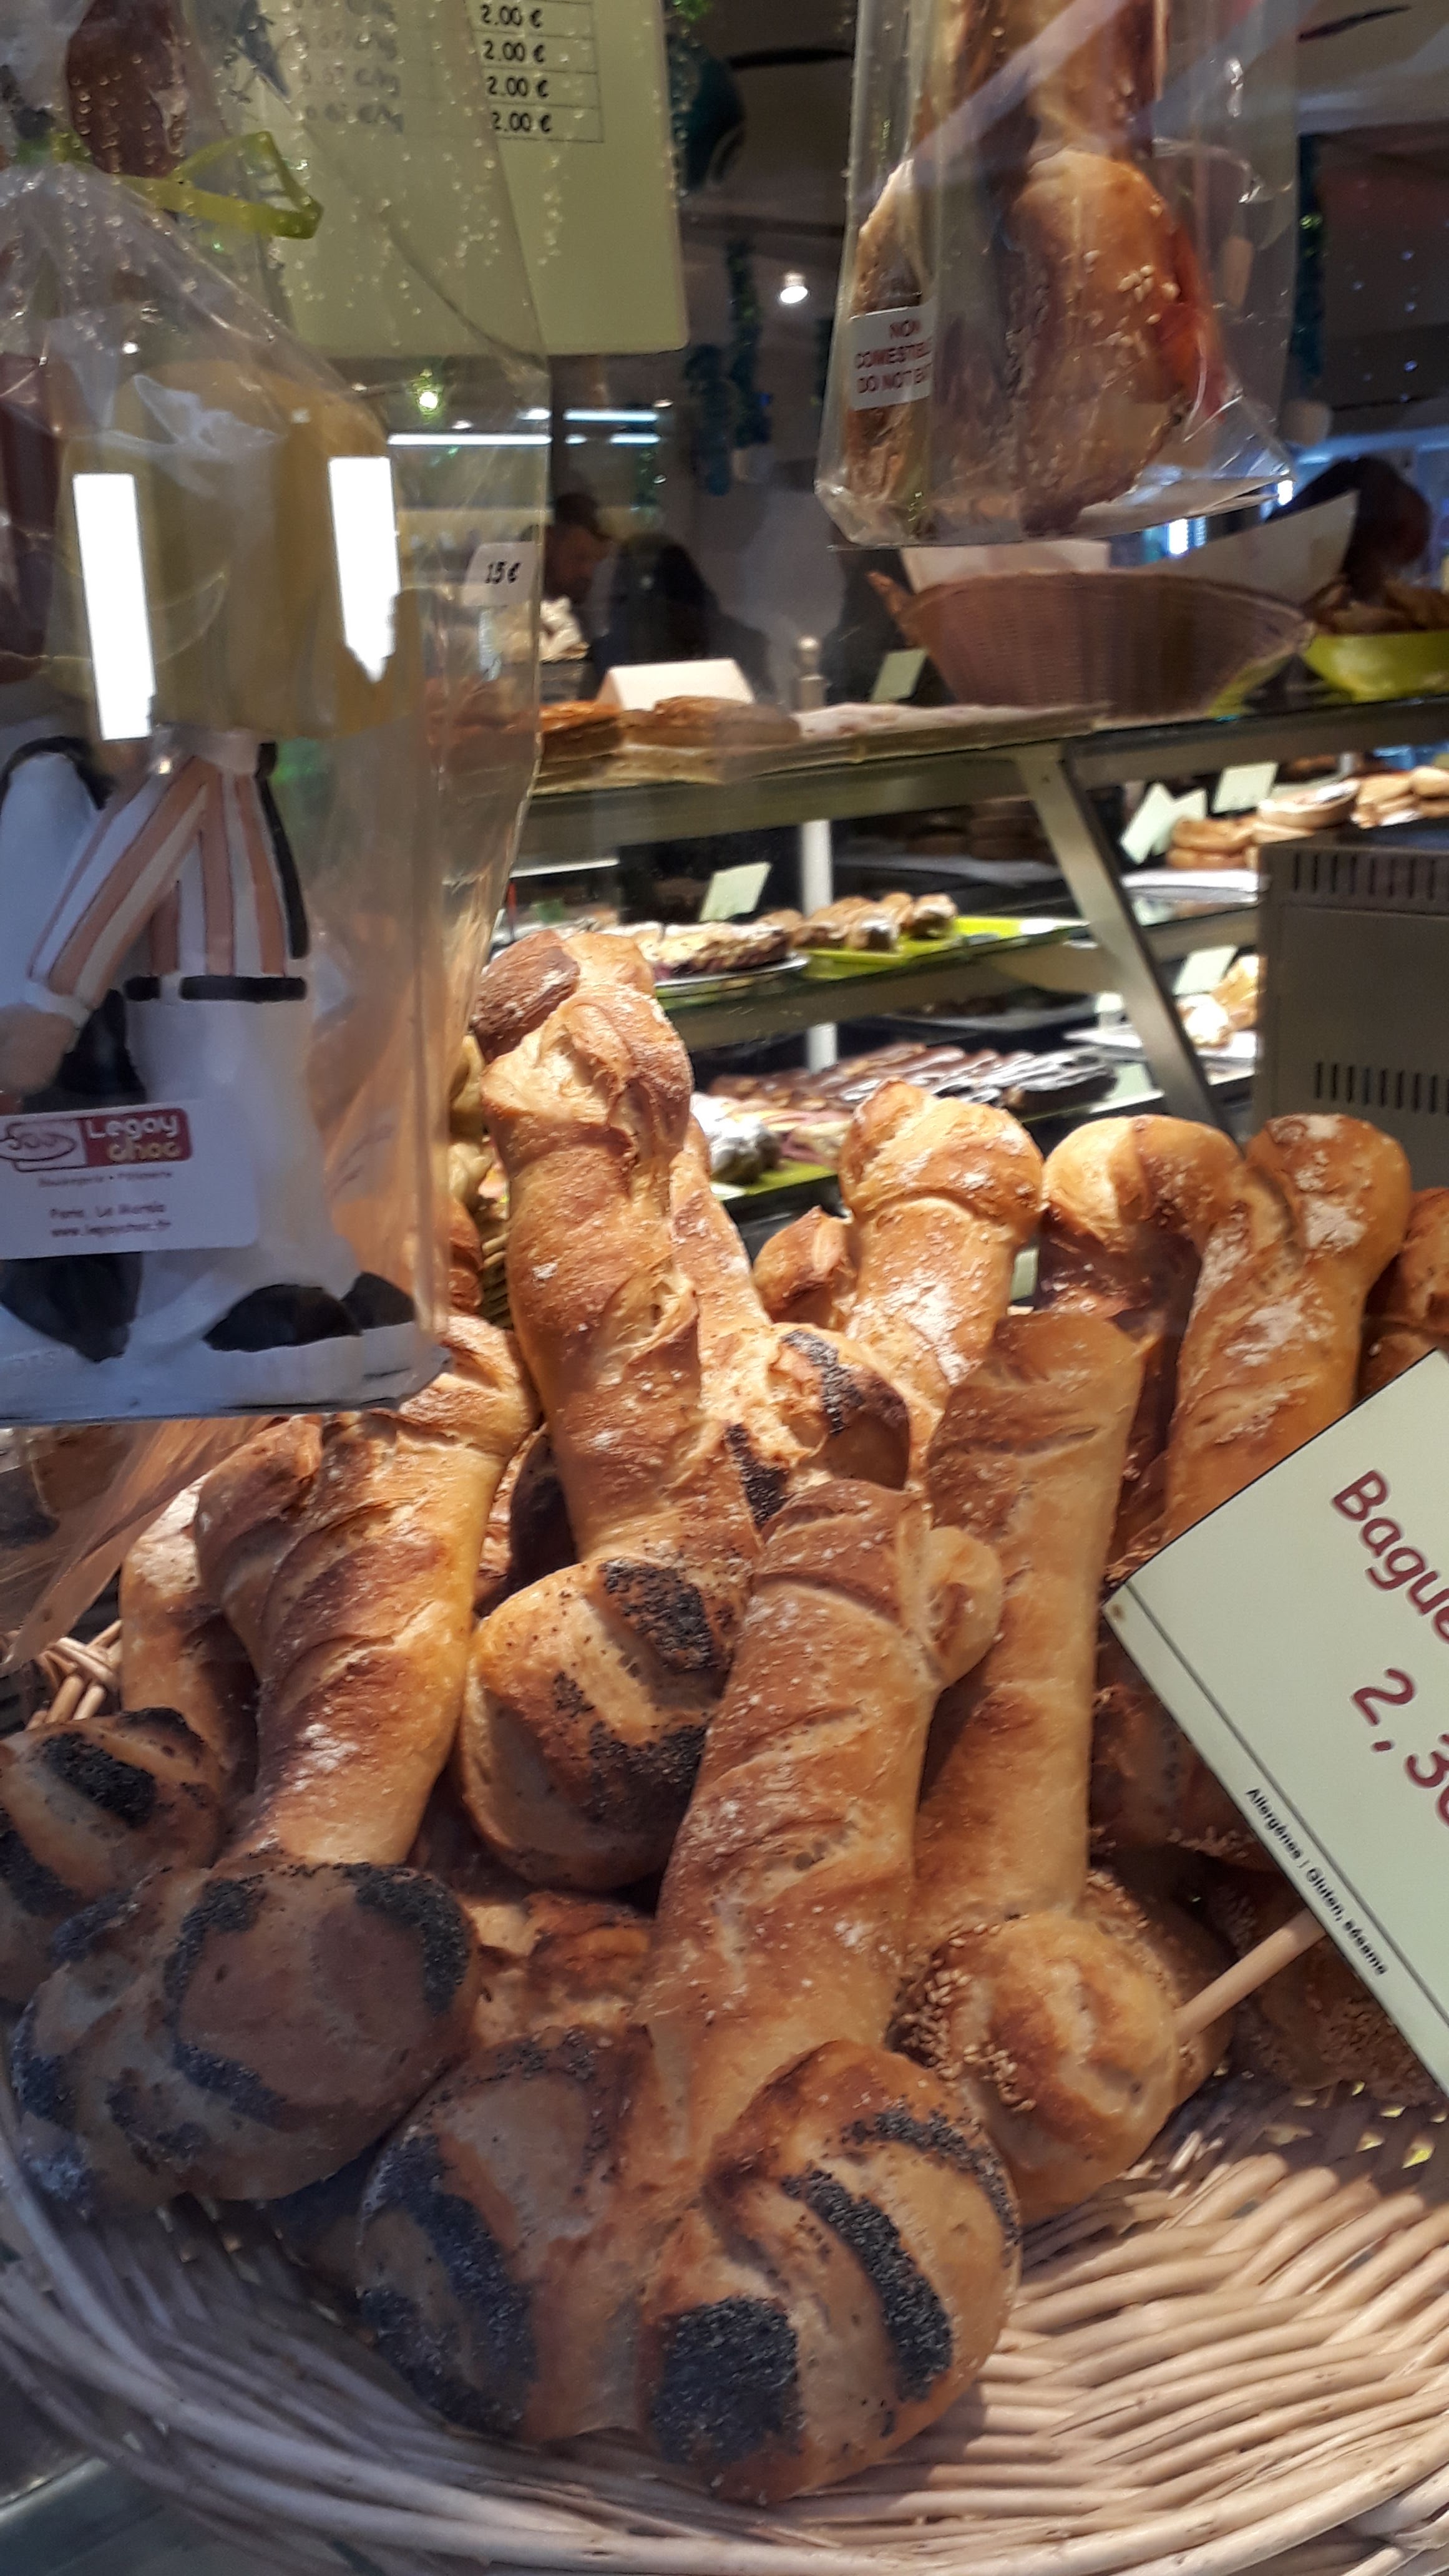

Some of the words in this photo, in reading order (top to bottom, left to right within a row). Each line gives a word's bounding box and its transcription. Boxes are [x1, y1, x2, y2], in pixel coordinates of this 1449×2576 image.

[481, 4, 522, 26] 2.00
[530, 9, 541, 27] €
[484, 40, 525, 62] 2.00
[534, 44, 544, 63] €
[487, 76, 528, 97] 2.00
[537, 79, 549, 97] €
[492, 112, 531, 132] 2.00
[540, 114, 551, 132] €
[857, 376, 877, 394] DO
[1350, 1668, 1449, 1827] 2,3
